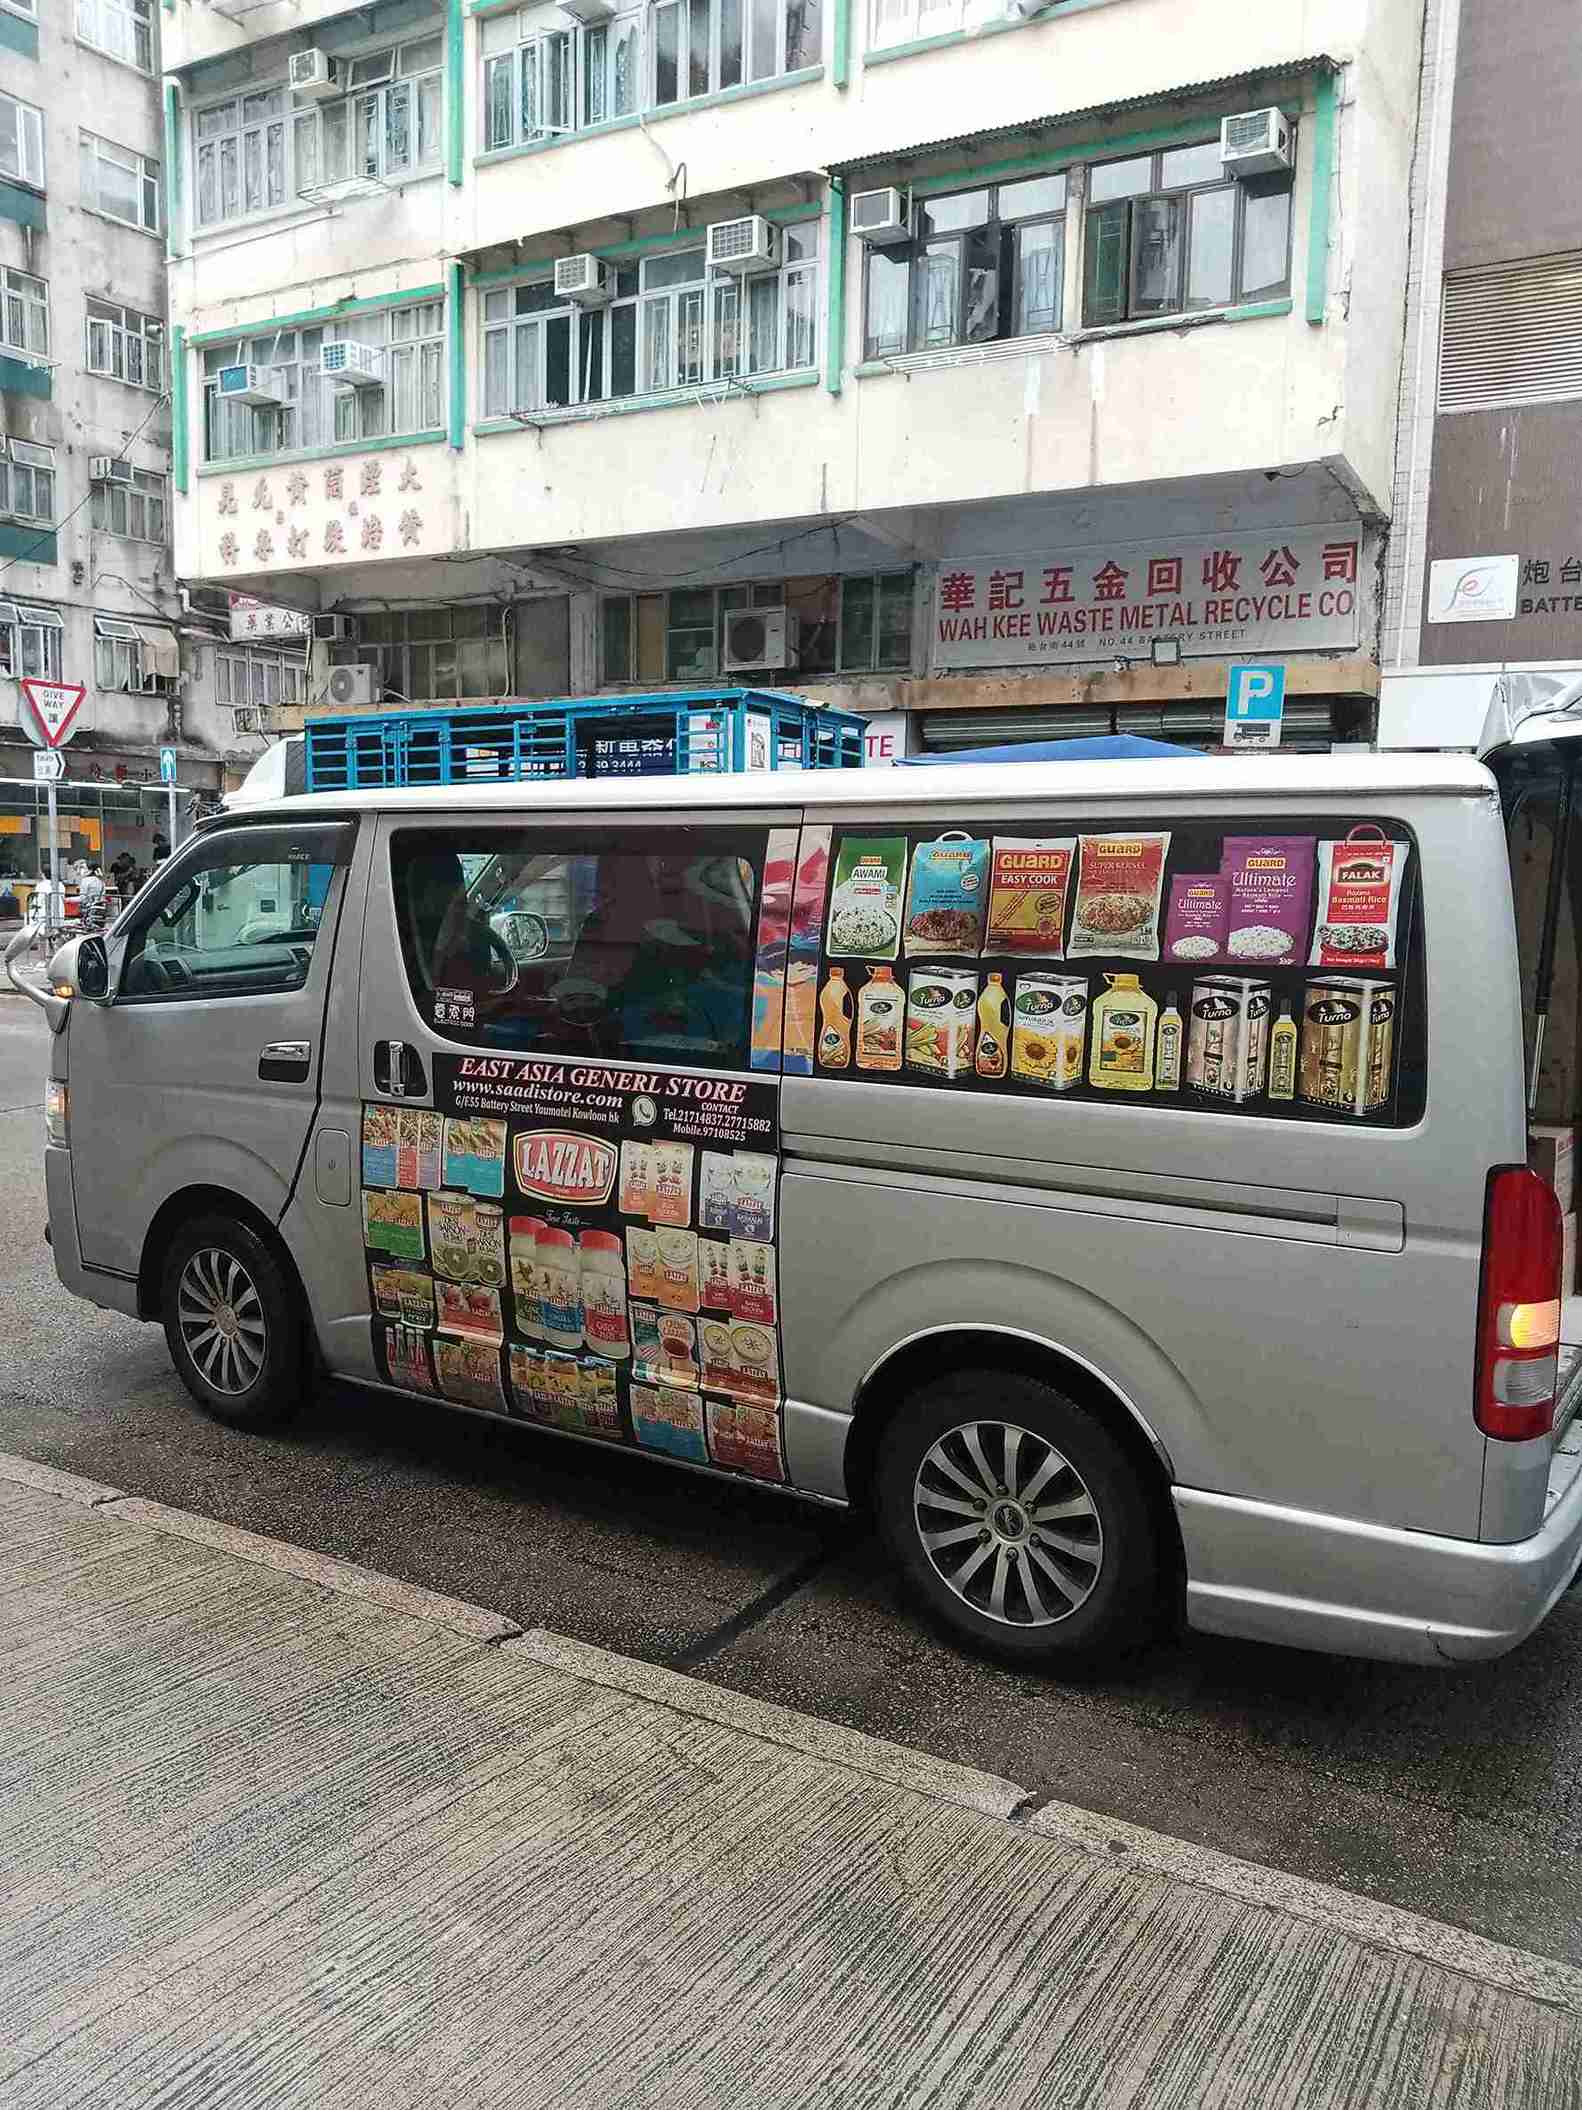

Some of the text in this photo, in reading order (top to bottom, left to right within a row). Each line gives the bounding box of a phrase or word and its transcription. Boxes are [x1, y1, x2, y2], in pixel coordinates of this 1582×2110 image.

[941, 542, 1358, 612] 華記五金回收公司
[939, 617, 987, 641] WAH
[993, 613, 1031, 638] KEE
[1037, 607, 1113, 635] WASTE
[1120, 601, 1198, 630] METAL
[1205, 593, 1312, 624] RECYCLE
[1199, 629, 1246, 641] STREET
[44, 689, 65, 699] GIVE
[1238, 670, 1273, 715] P
[44, 699, 64, 709] WAY
[1099, 844, 1141, 854] GUARD
[1000, 854, 1062, 870] GUARD
[1248, 859, 1285, 868] GUARD
[853, 867, 887, 880] AWAMI
[1001, 874, 1058, 885] EASY COOK
[1232, 871, 1296, 887] Ultimate
[1342, 871, 1381, 880] FALAK
[460, 1058, 747, 1103] EAST ASIA GENERL STORE
[453, 1080, 623, 1108] www.saadistore.com
[480, 1098, 509, 1113] Battery
[510, 1101, 533, 1114] Street
[572, 1108, 607, 1121] Kowloon
[701, 1102, 739, 1114] CONTACT
[522, 1141, 610, 1188] LAZZAT
